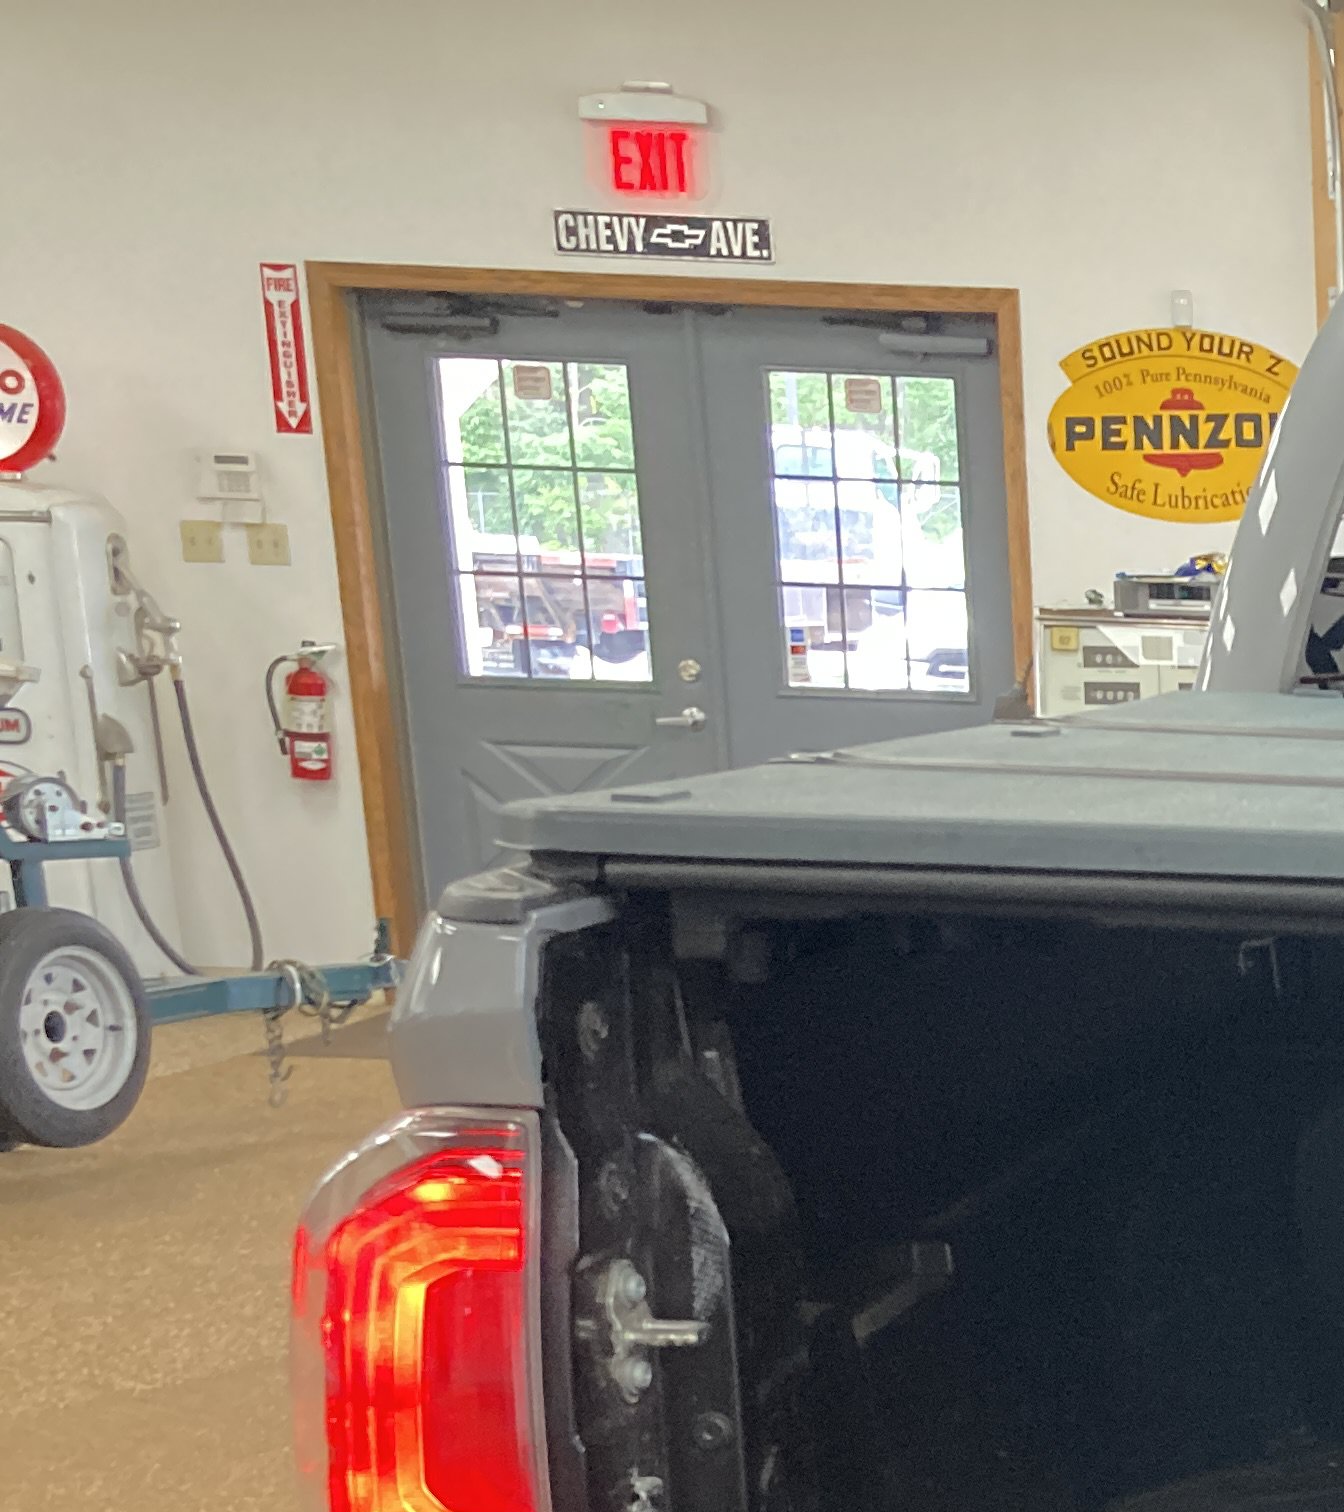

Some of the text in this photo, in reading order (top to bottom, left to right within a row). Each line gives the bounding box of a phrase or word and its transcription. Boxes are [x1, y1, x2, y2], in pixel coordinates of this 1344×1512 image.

[611, 129, 688, 192] EXIT
[557, 213, 769, 258] CHEVY AVE.
[266, 277, 294, 293] FIRE
[1081, 331, 1173, 369] SOUND
[1182, 331, 1254, 365] YOUR
[1094, 366, 1272, 404] 100% Pure Pennsylvania
[1106, 470, 1147, 505] Safe
